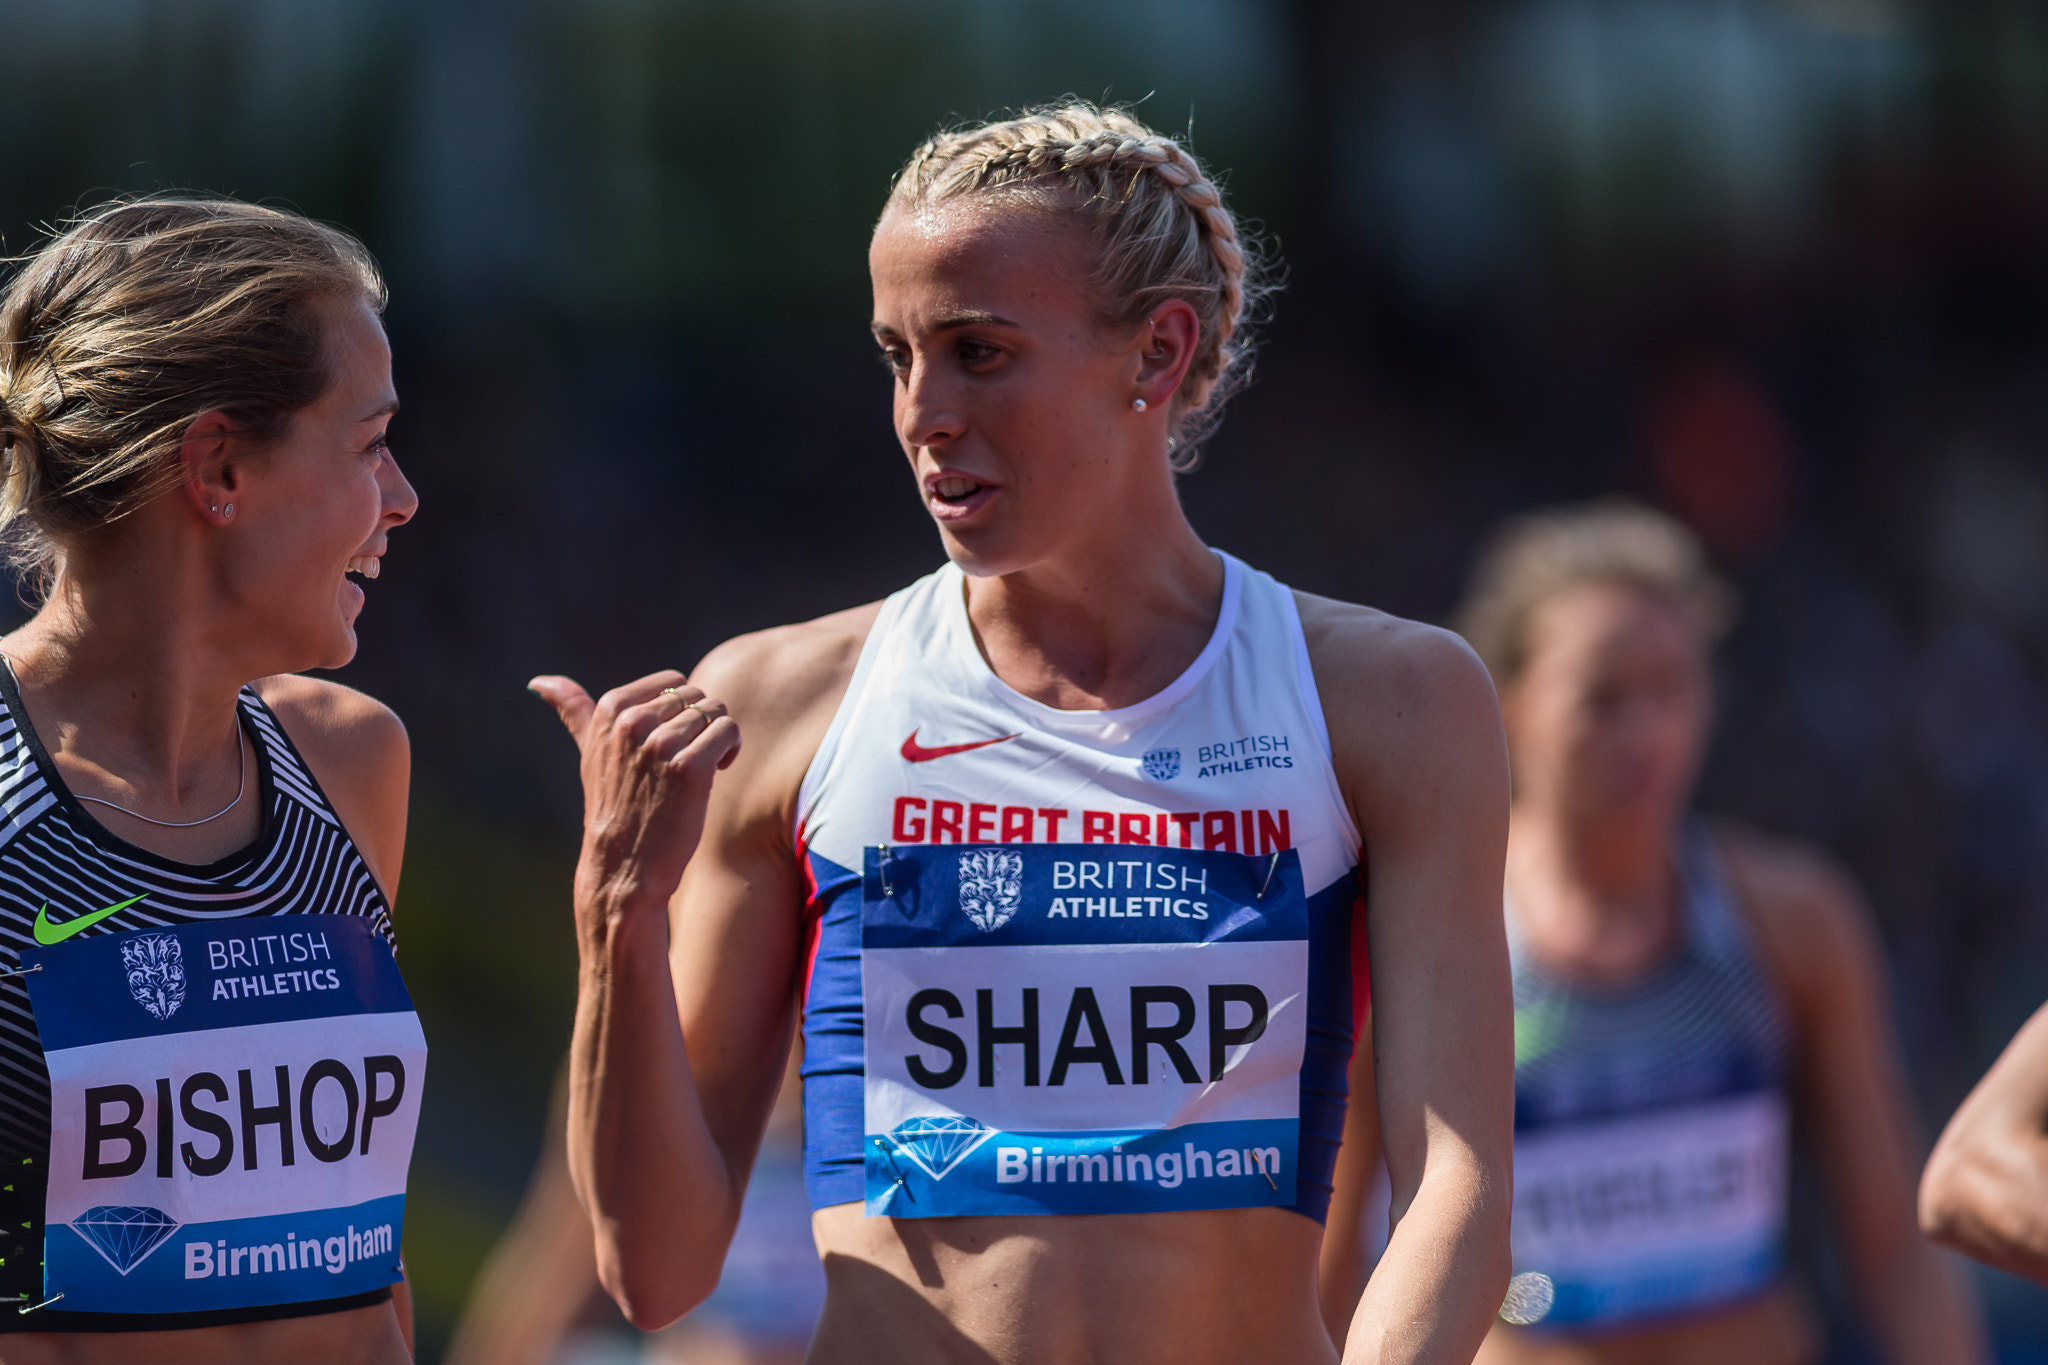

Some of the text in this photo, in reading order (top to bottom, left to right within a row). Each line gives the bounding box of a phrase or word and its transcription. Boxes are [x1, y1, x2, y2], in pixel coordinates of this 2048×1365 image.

[1198, 735, 1288, 763] BRITISH
[1198, 756, 1293, 778] ATHLETICS
[892, 796, 1291, 856] GREAT BRITAIN
[1052, 861, 1207, 895] BRITISH
[1047, 897, 1209, 920] ATHLETICS
[207, 932, 331, 971] BRITISH
[212, 968, 340, 1001] ATHLETICS
[904, 984, 1269, 1089] SHARP
[82, 1054, 405, 1180] BISHOP
[996, 1142, 1281, 1188] Birmingham
[185, 1221, 392, 1279] Birmingham
